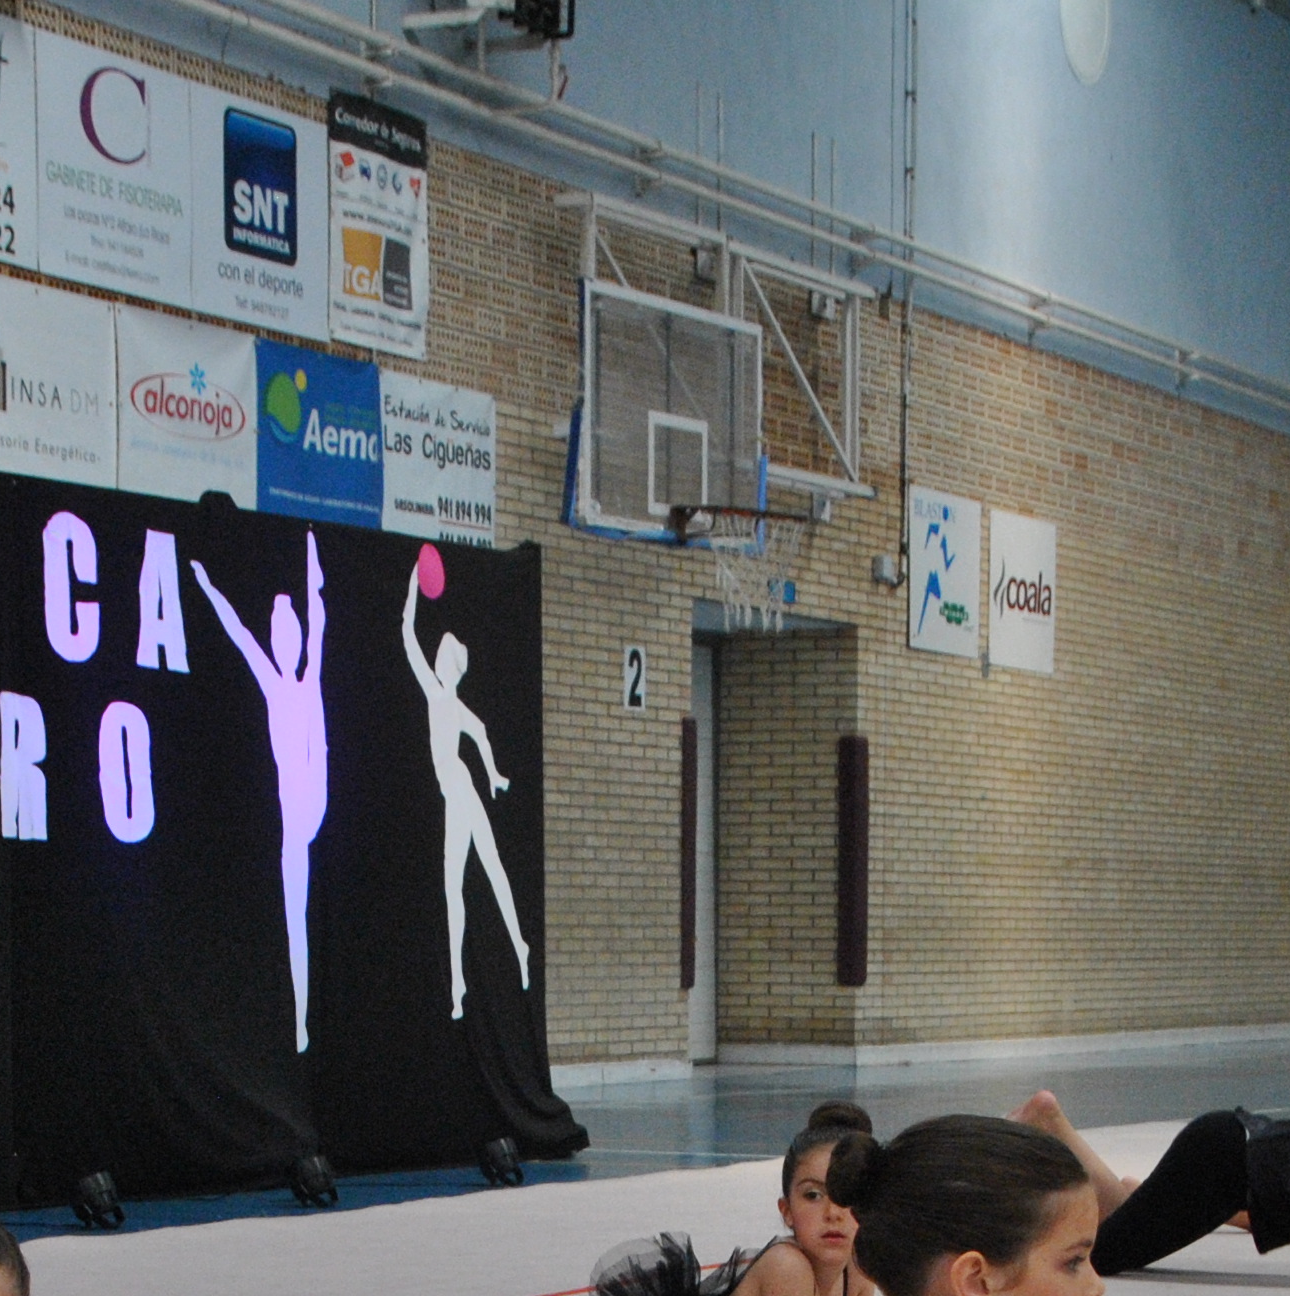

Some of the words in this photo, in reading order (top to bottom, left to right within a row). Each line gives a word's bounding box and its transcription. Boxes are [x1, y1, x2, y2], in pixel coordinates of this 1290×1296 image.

[79, 66, 146, 165] C
[98, 172, 114, 200] DE
[233, 179, 288, 234] SNT
[217, 261, 241, 281] con
[244, 265, 255, 285] el
[258, 268, 304, 299] deporte
[144, 378, 233, 437] alconoja
[384, 394, 431, 424] Estación
[435, 411, 446, 428] de
[450, 411, 491, 438] Servicio
[384, 424, 412, 456] Las
[422, 433, 492, 472] Cigüeñas
[438, 495, 453, 519] 941
[455, 499, 472, 522] 894
[474, 501, 492, 526] 994
[1006, 570, 1053, 617] coala
[628, 648, 642, 707] 2
